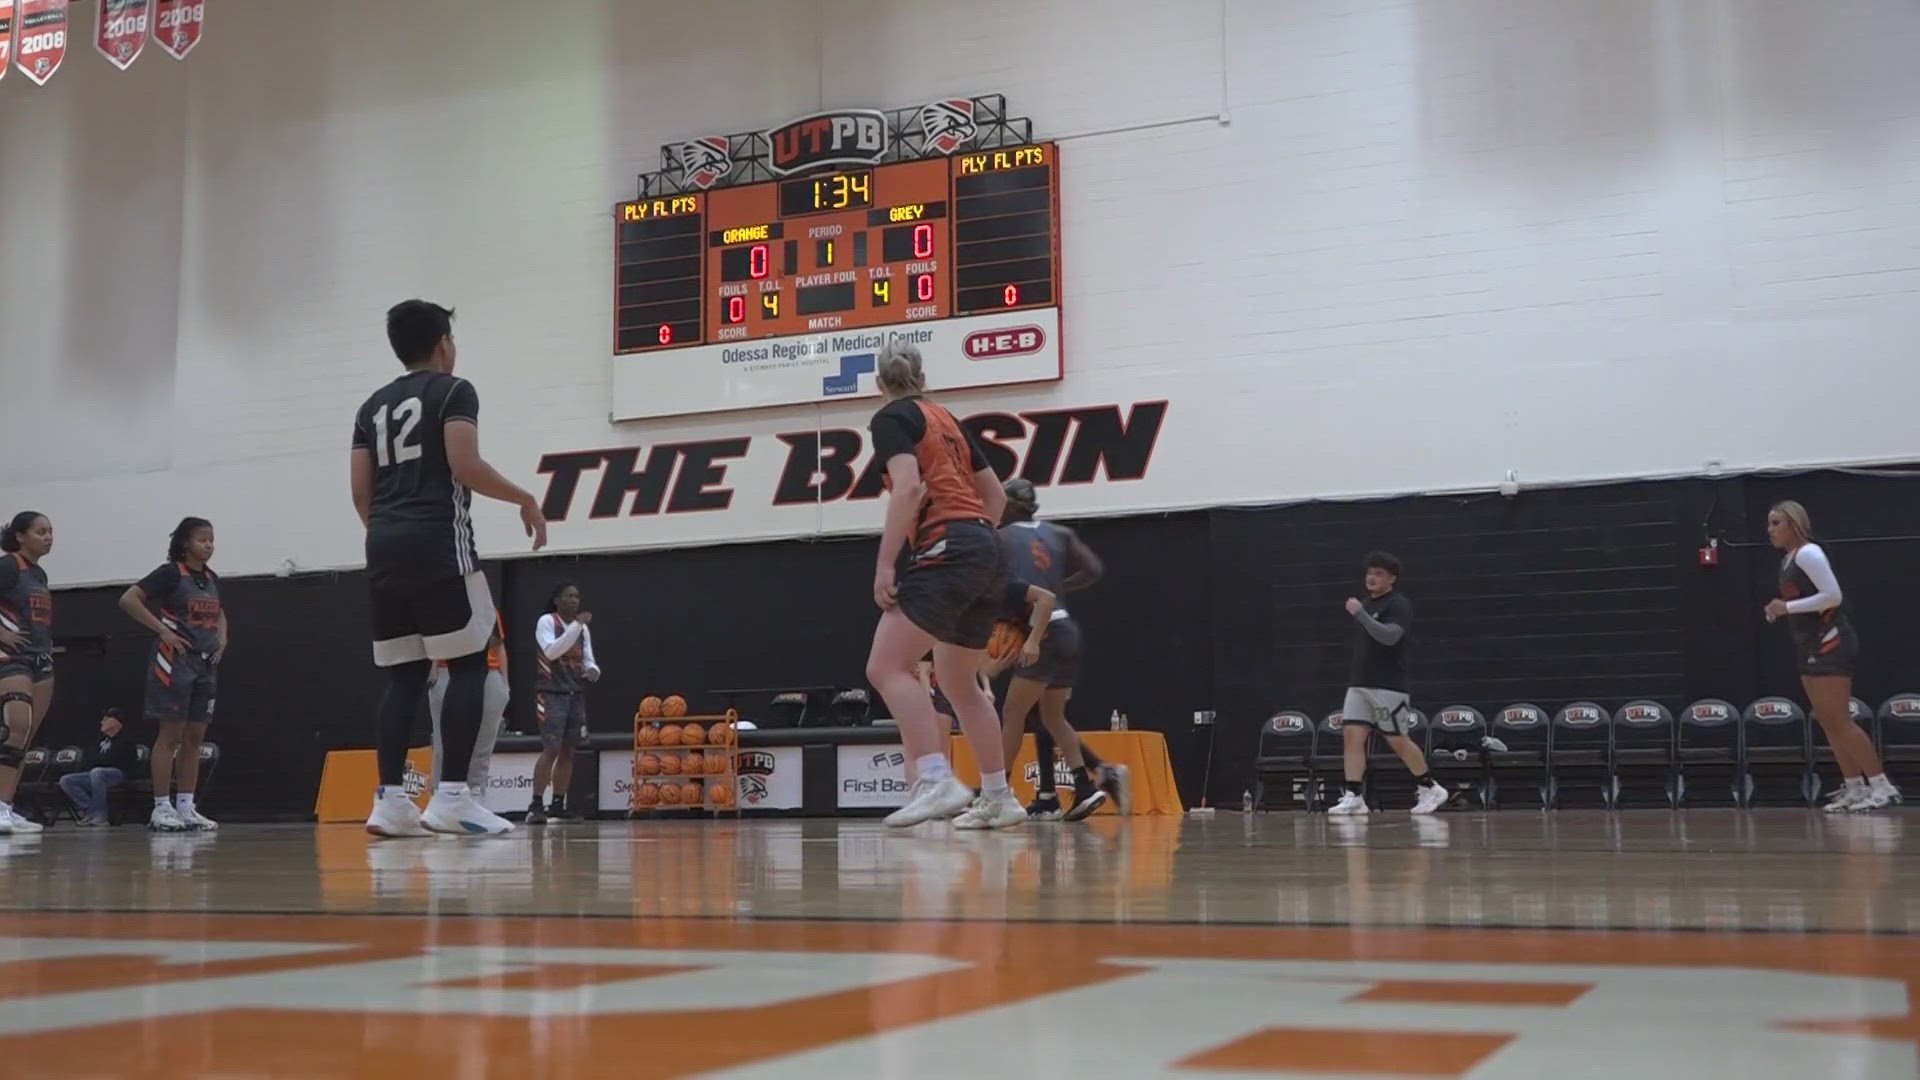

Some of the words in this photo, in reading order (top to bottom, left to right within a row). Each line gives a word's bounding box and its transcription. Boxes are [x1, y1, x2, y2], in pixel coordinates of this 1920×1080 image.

[159, 4, 203, 28] 2008
[104, 15, 147, 39] 2008
[21, 31, 65, 54] 2008
[774, 116, 881, 166] UTPB
[962, 156, 986, 174] PLY
[994, 153, 1011, 169] FL
[1016, 148, 1043, 167] PTS
[814, 174, 869, 209] 1:34
[625, 203, 648, 220] PLY
[653, 201, 668, 216] FL
[671, 197, 696, 214] PTS
[889, 205, 924, 222] GREY
[723, 225, 769, 244] ORANGE
[808, 224, 843, 238] PERIOD
[913, 224, 931, 258] 0
[750, 245, 767, 279] 0
[826, 242, 832, 264] 1
[868, 267, 895, 279] T.O.L.
[906, 261, 938, 275] FOULS
[718, 283, 748, 297] FOULS
[758, 280, 784, 292] T.O.L.
[795, 274, 831, 288] PLAYER
[834, 271, 857, 284] FOUL
[918, 274, 932, 301] 0
[873, 281, 889, 303] 4
[1004, 285, 1017, 306] 0
[729, 296, 743, 322] 0
[763, 296, 778, 316] 4
[906, 305, 938, 319] SCORE
[718, 326, 748, 340] SCORE
[808, 316, 842, 330] MATCH
[659, 325, 671, 344] 0
[722, 347, 768, 364] Odessa
[772, 338, 828, 359] Regional
[832, 332, 886, 353] Medical
[888, 329, 933, 350] Center
[825, 382, 857, 394] Steward
[372, 396, 422, 467] 12
[537, 435, 752, 523] THE
[772, 400, 1170, 507] BSIN
[1275, 717, 1302, 727] UTPB
[843, 779, 877, 793] First
